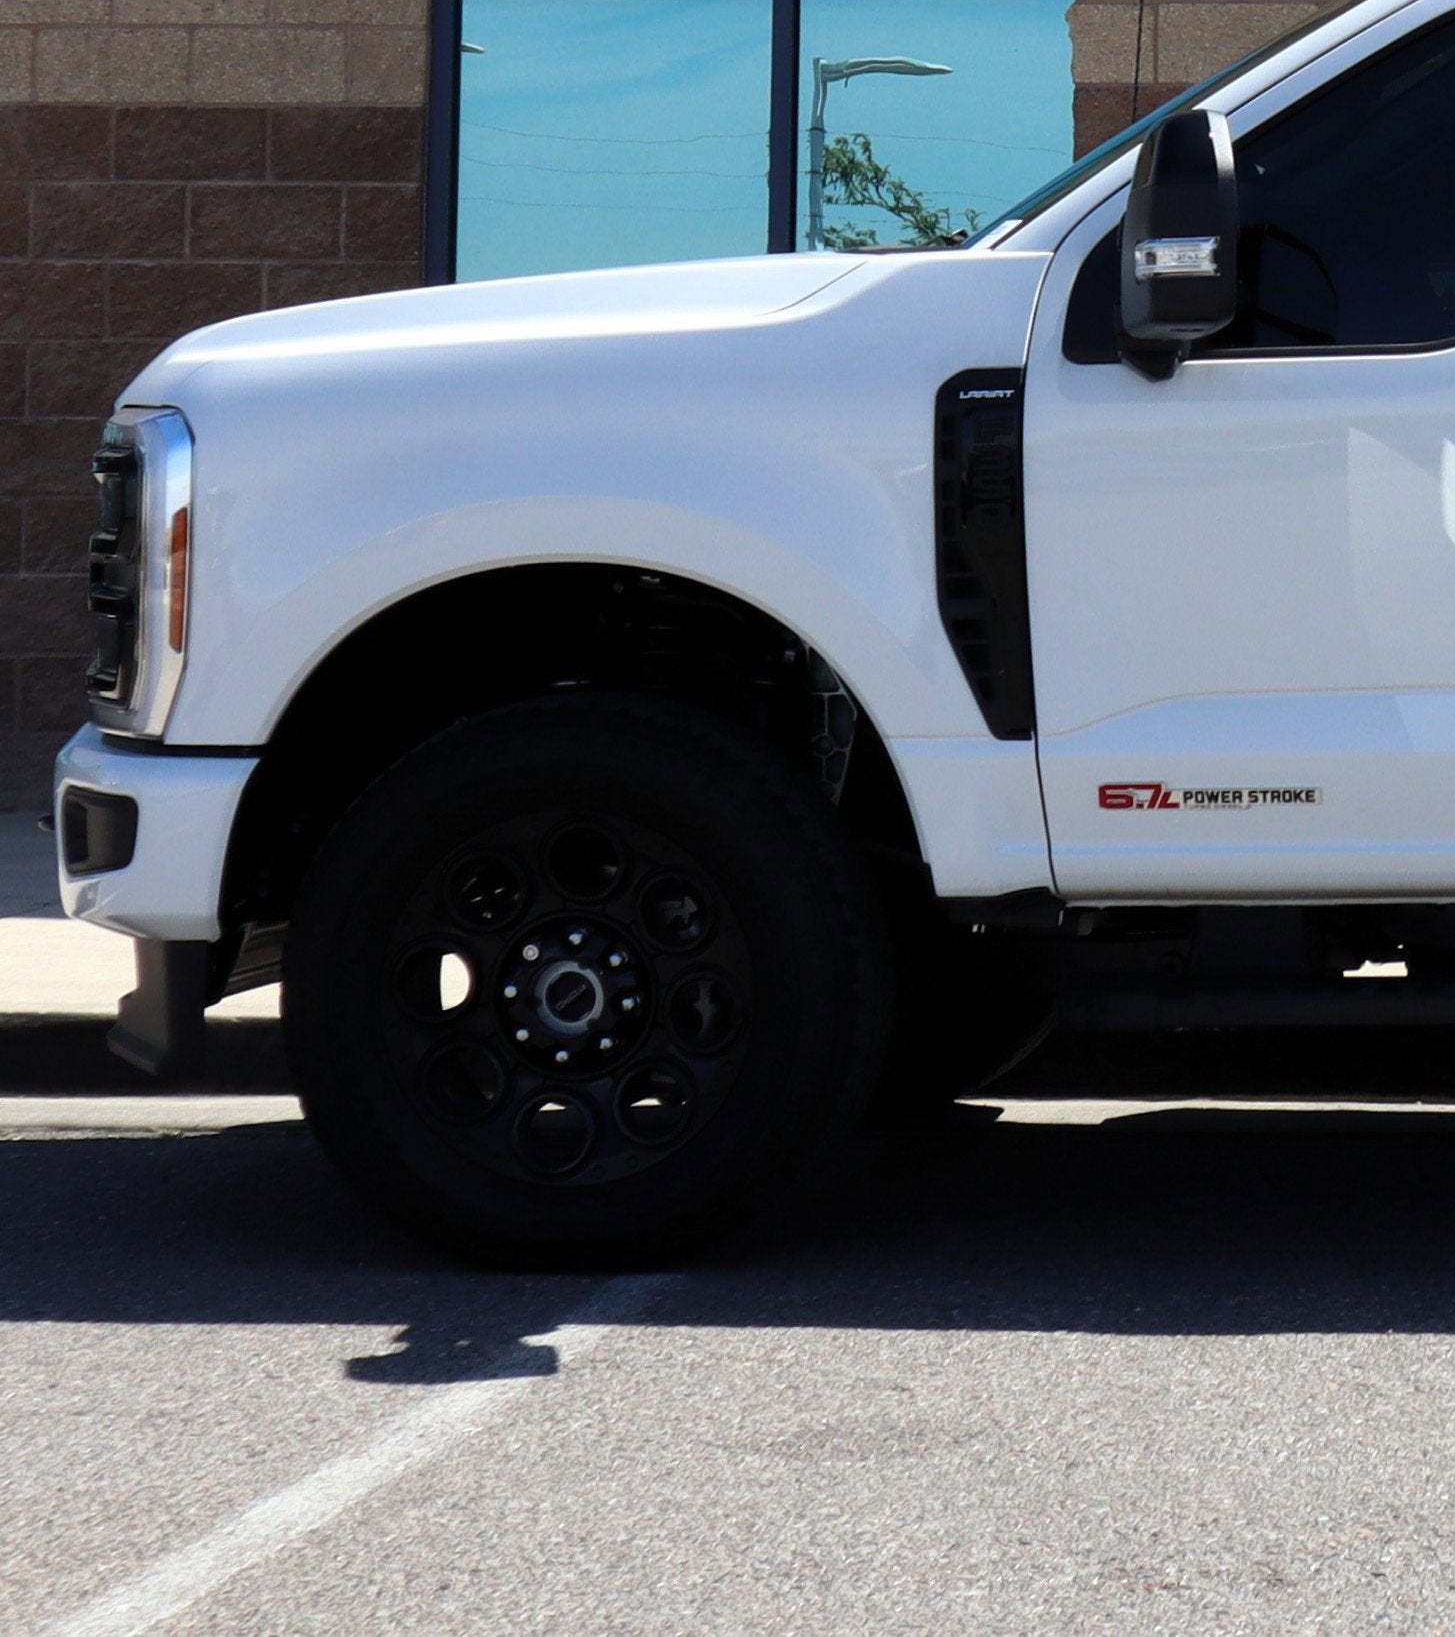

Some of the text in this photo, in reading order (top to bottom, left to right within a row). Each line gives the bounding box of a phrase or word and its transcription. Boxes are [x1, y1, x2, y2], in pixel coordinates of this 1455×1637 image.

[959, 390, 1015, 399] LARIAT
[1098, 783, 1180, 809] 6.7L
[1183, 791, 1243, 804] POWER
[1249, 790, 1316, 803] STROKE
